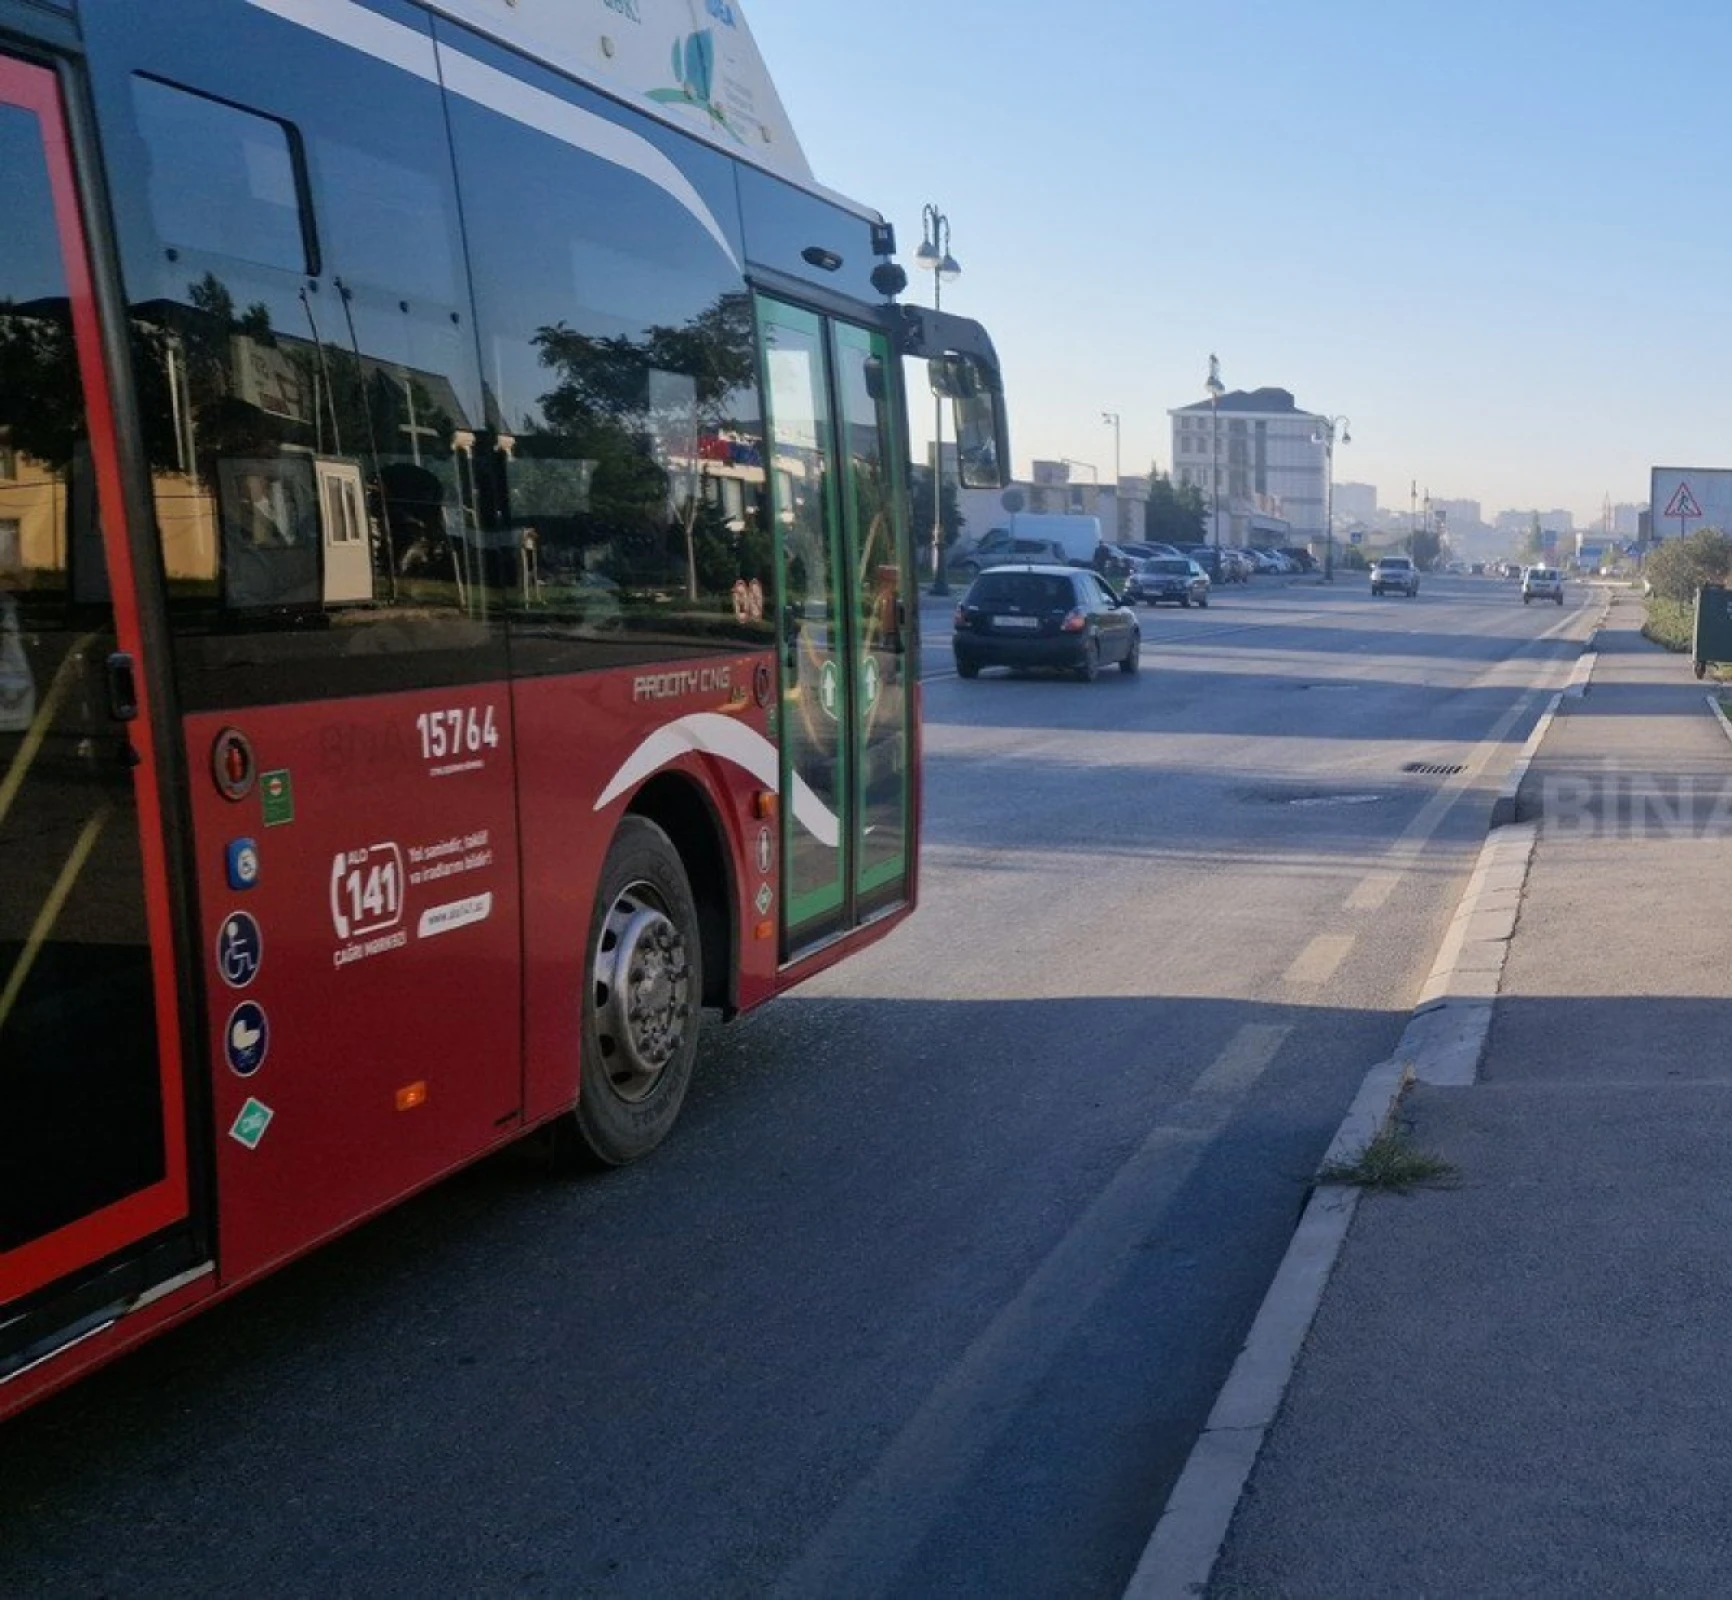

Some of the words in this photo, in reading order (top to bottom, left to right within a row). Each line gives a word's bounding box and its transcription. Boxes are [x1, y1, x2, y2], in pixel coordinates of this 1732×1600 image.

[700, 665, 732, 692] CNG
[416, 705, 498, 758] 15764
[345, 861, 397, 921] 141
